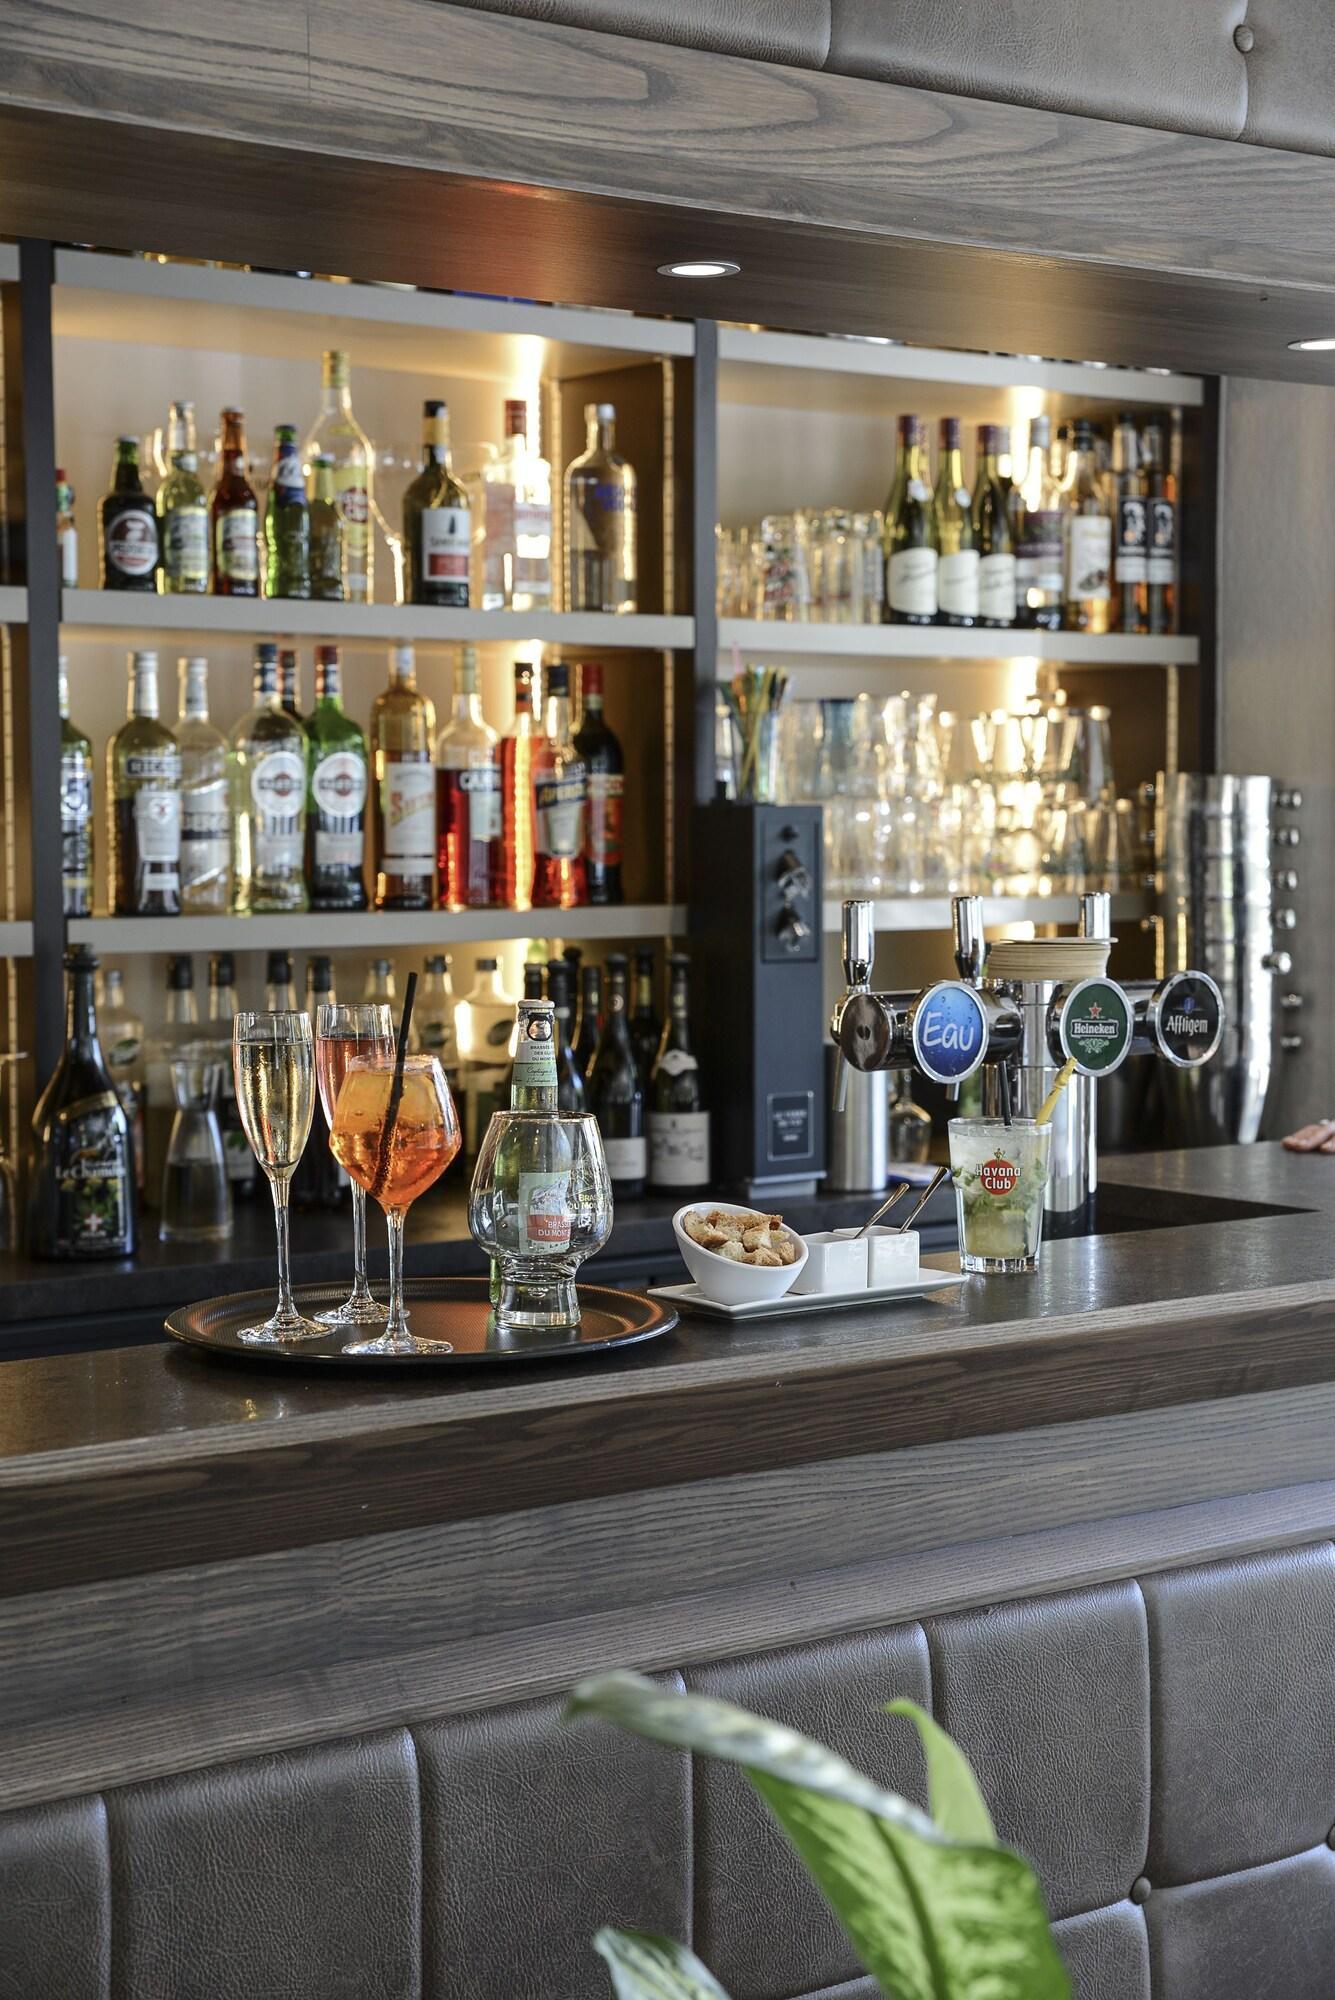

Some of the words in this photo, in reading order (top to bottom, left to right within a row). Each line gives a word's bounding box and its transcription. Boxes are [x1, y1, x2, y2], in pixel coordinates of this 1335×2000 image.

[923, 1011, 974, 1051] Eau
[1073, 1023, 1116, 1034] Heineken
[1165, 1015, 1209, 1036] Affligem
[974, 1163, 1022, 1178] Havana
[985, 1177, 1012, 1189] Club
